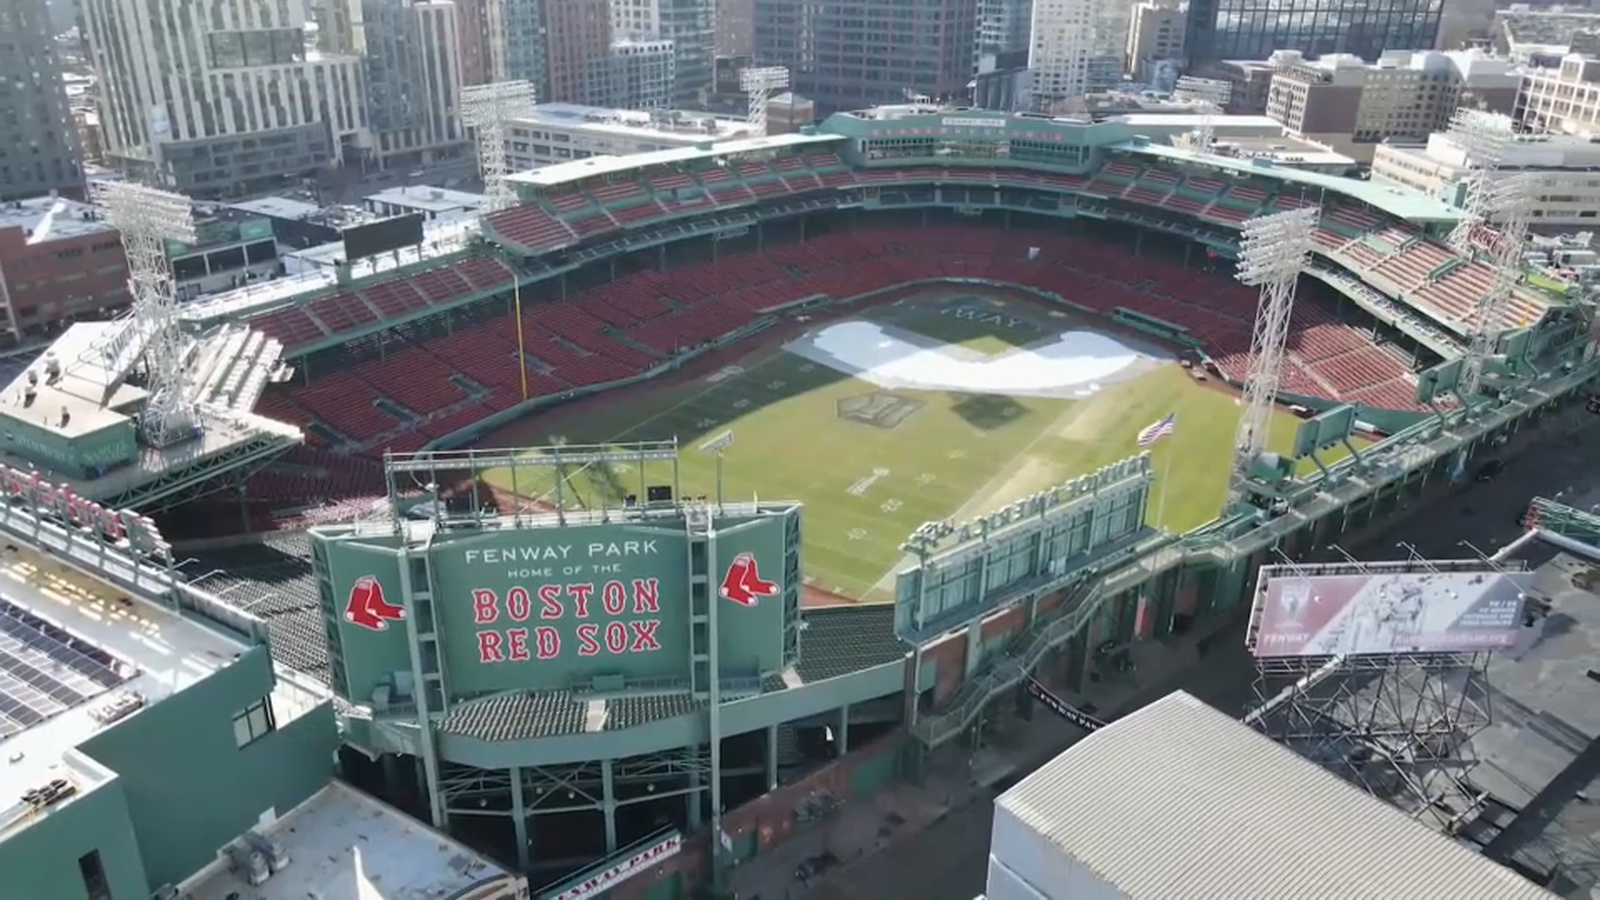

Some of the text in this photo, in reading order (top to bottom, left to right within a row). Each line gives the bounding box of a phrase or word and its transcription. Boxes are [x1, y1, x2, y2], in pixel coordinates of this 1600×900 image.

[465, 540, 659, 564] FENWAY PARK
[507, 563, 622, 578] HOME OF THE
[471, 578, 660, 624] BOSTON
[476, 619, 661, 663] RED SOX
